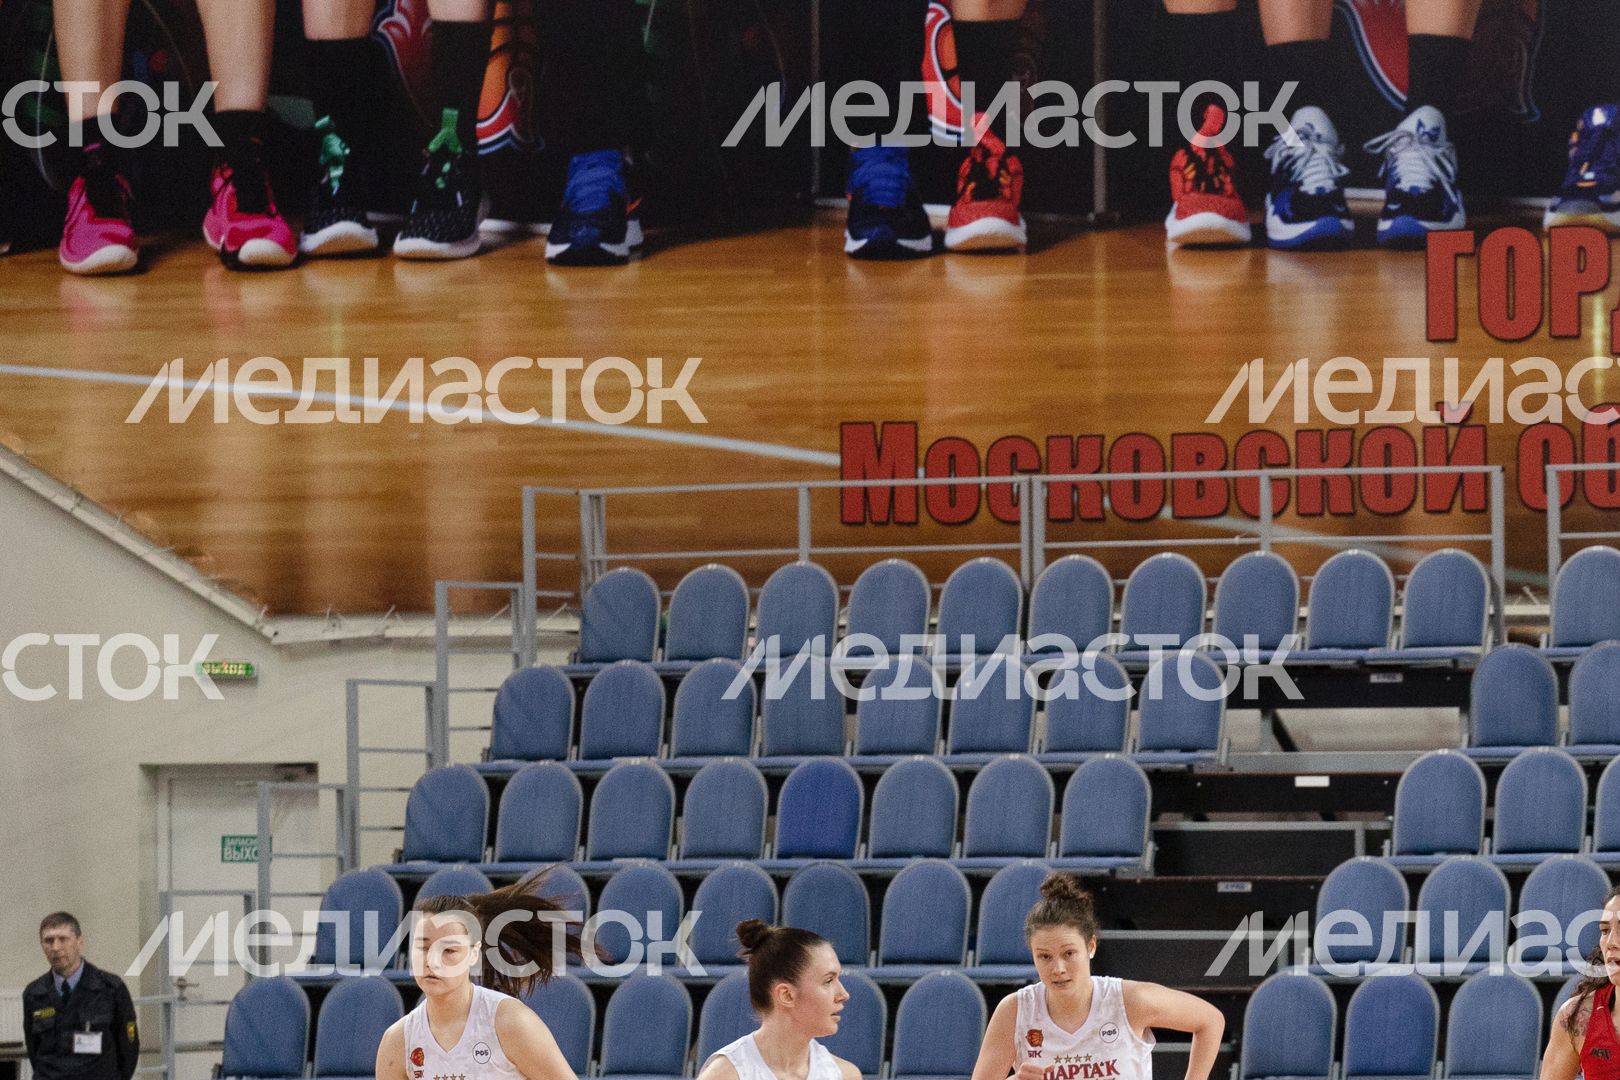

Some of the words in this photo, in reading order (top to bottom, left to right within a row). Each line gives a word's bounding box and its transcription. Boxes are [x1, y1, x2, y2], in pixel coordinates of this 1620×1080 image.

[839, 400, 1488, 526] Московской
[223, 847, 259, 860] ВЫХО
[1043, 1059, 1121, 1080] ПАРТАК
